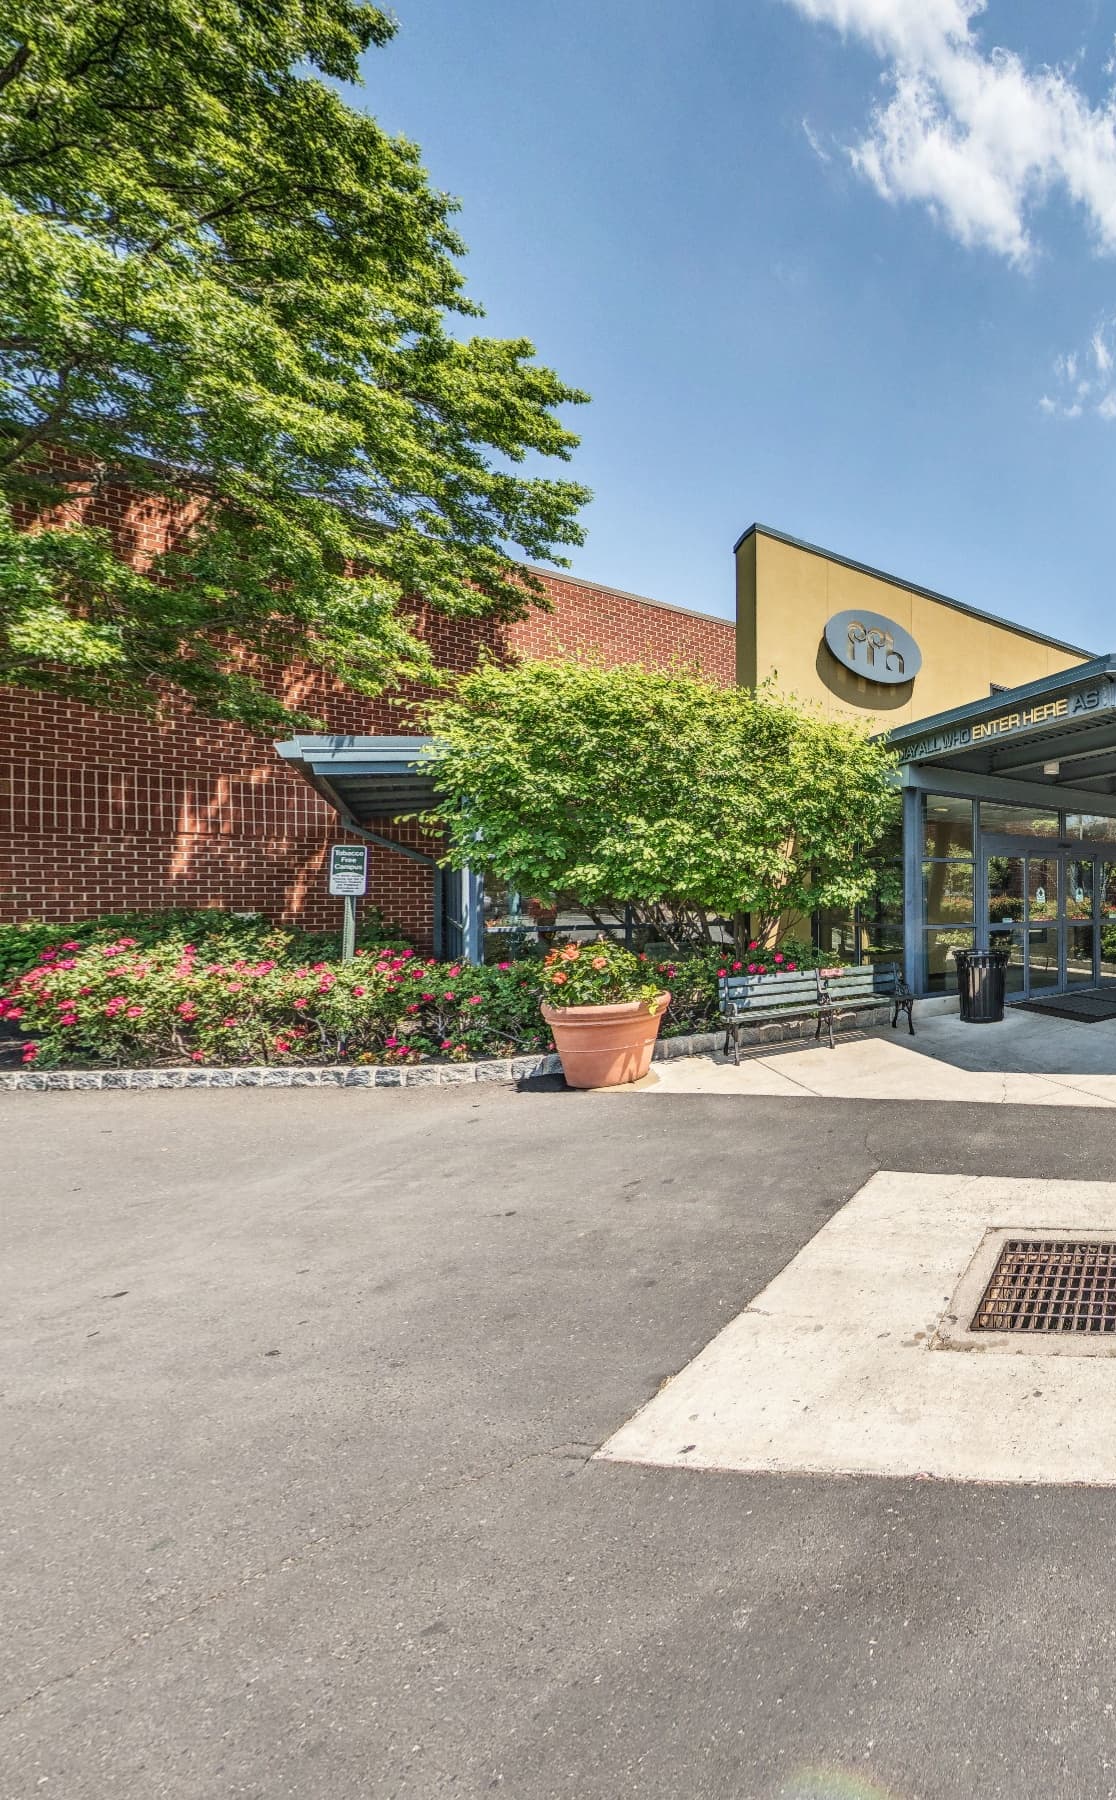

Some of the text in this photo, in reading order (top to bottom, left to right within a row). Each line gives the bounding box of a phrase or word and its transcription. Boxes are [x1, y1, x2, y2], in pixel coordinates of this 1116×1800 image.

[919, 735, 942, 755] ALL
[942, 728, 971, 749] WHO
[972, 713, 1021, 740] ENTER
[1022, 698, 1068, 726] HERE
[1072, 690, 1100, 712] AS
[334, 863, 363, 871] Campus
